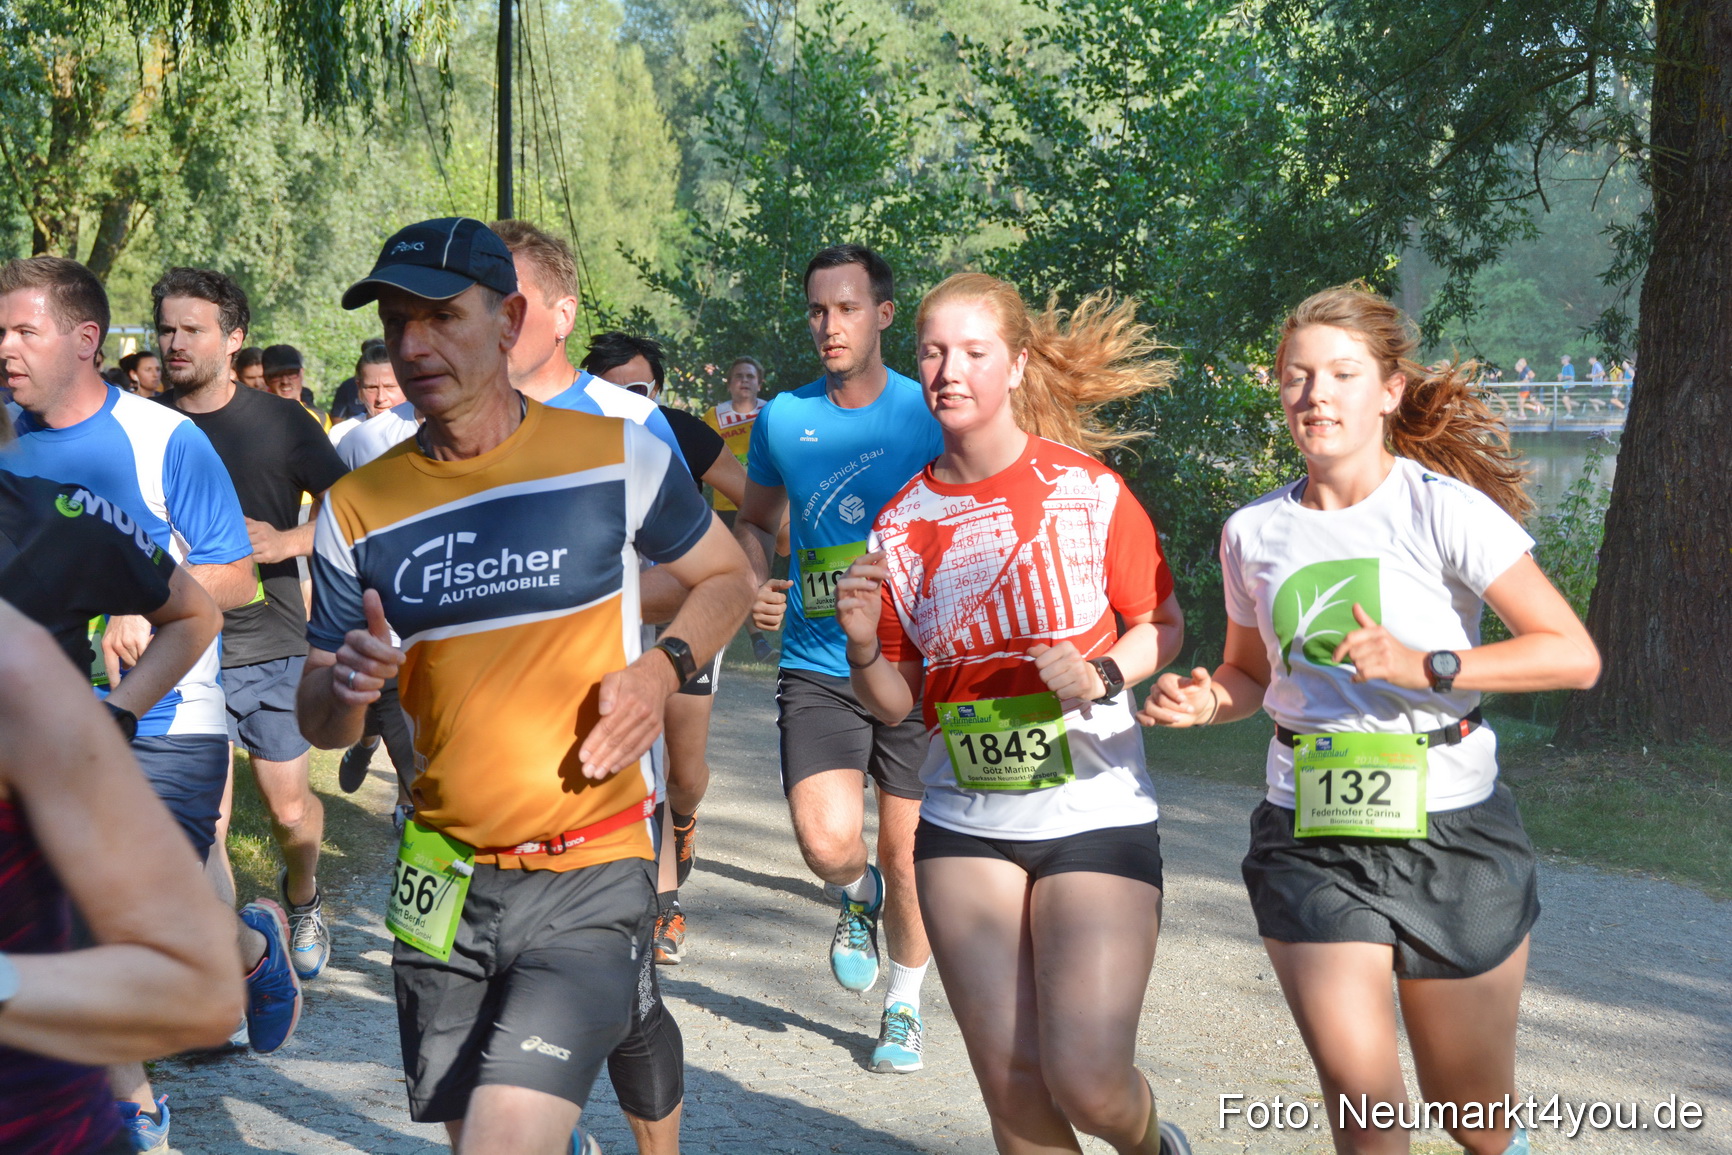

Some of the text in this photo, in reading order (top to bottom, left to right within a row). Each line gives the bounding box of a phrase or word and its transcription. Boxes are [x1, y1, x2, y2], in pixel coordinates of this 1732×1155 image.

[820, 461, 859, 490] Schick
[860, 448, 884, 463] Bau
[943, 499, 974, 517] 10.54
[422, 548, 568, 593] Fischer
[952, 553, 984, 569] 52.01
[438, 574, 561, 606] AUTOMOBILE
[954, 570, 988, 589] 26.22
[960, 728, 1051, 765] 1843
[982, 764, 1036, 775] Götz Marina
[1318, 769, 1391, 806] 132
[1311, 807, 1401, 818] Federhofer Carina
